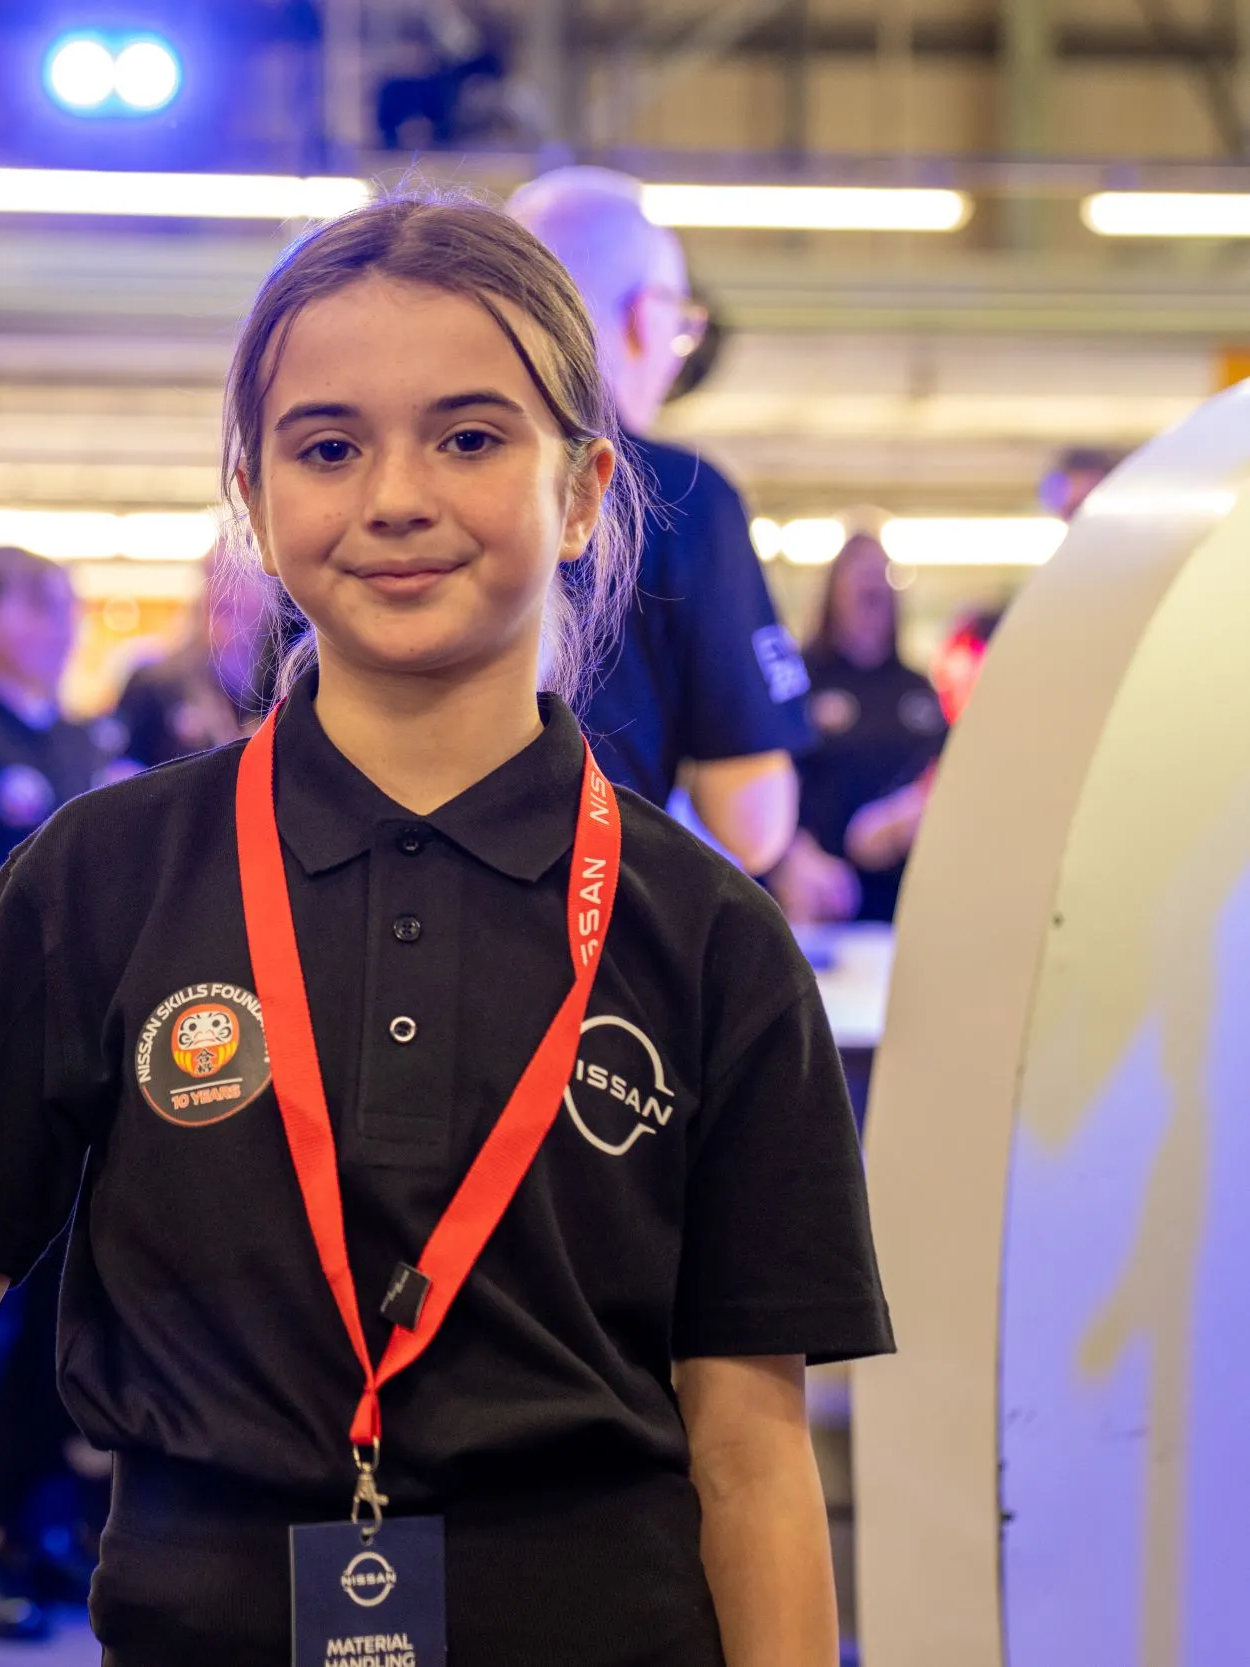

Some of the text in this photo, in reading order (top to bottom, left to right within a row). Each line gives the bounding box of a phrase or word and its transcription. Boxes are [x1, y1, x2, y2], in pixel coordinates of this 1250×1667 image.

[137, 1019, 162, 1083] NISSAN
[156, 984, 208, 1020] SKILLS
[171, 1085, 241, 1110] 10 YEARS
[575, 1059, 673, 1126] ISSAN
[340, 1572, 397, 1587] NISSAN
[327, 1633, 413, 1657] MATERIAL
